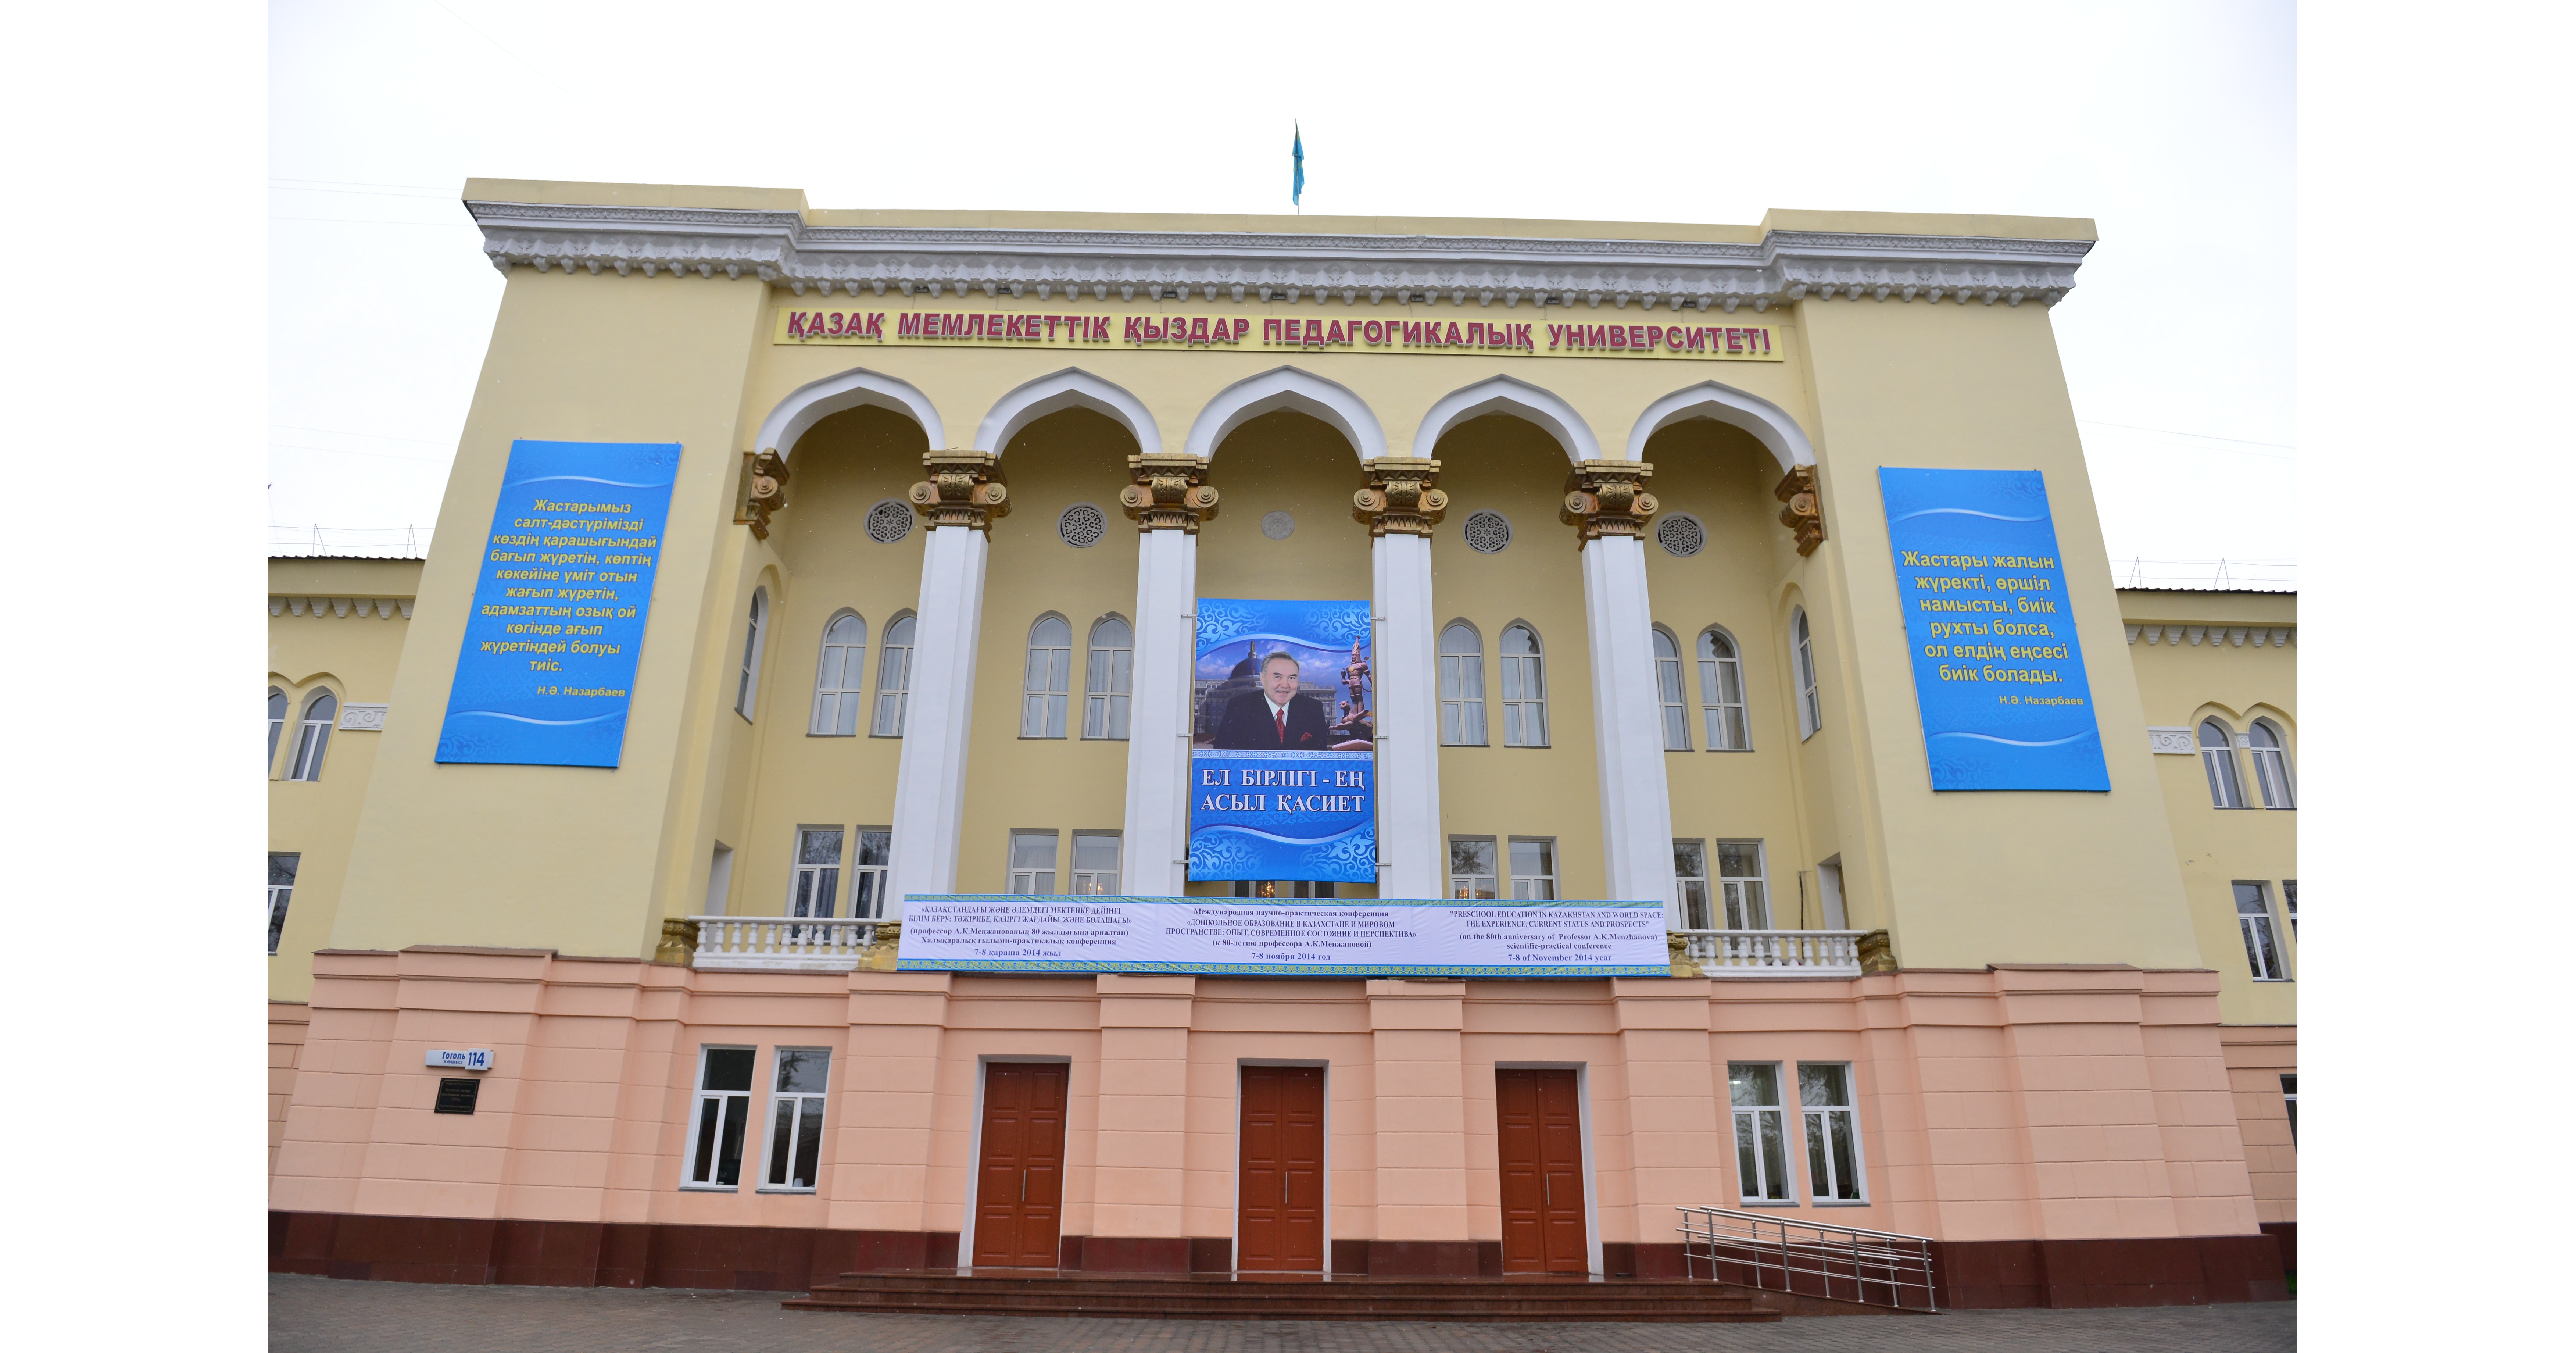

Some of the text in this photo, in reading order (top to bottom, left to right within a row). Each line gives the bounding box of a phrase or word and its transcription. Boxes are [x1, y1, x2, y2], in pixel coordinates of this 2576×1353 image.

[788, 312, 1771, 352] ҚАЗАҚ МЕМЛЕКЕТТІК ҚЫЗДАР ПЕДАГОГИКАЛЫҚ УНИВЕРСИТЕТІ
[533, 499, 632, 515] Жастарымыз
[514, 517, 644, 532] салт-дәстүрімізді
[493, 533, 657, 549] көздің қарашығындай
[490, 549, 652, 567] бағып жүретін, көптің
[1901, 551, 2055, 571] Жастары жалын
[496, 568, 637, 583] көкейіне үміт отын
[1915, 574, 2051, 594] жүректі, өршіл
[505, 587, 618, 601] жағып жүретін,
[481, 605, 636, 620] адамзаттың озық ой
[1920, 597, 2056, 615] намысты, биік
[506, 621, 603, 636] көгінде ағып
[1930, 619, 2054, 639] рухты болса,
[480, 639, 621, 657] жүретіндей болуы
[1925, 642, 2068, 661] ол елдің еңсесі
[530, 658, 562, 671] тиіс.
[1939, 664, 2063, 685] биік болады.
[537, 686, 626, 698] Н.Ә. Назарбаев
[1999, 695, 2084, 707] Н.Ә. Назарбаев
[1202, 770, 1230, 785] ЕЛ
[1242, 770, 1316, 786] БІРЛІГІ
[1335, 771, 1364, 790] ЕҢ
[1201, 794, 1364, 814] АСЫЛ ҚАСИЕТ
[1022, 915, 1059, 924] ЖАҒДАЙЫ
[1194, 908, 1254, 917] Международная
[1339, 910, 1388, 918] конференция
[910, 928, 952, 936] (профессор
[1504, 933, 1545, 942] anniversary
[1066, 938, 1116, 946] конференция
[1259, 940, 1302, 948] профессора
[1305, 940, 1371, 949] А.К.Менжановой)
[1507, 943, 1572, 951] scientific-practical
[1266, 953, 1295, 961] ноября
[442, 1052, 466, 1060] Гоголь
[468, 1052, 485, 1066] 114
